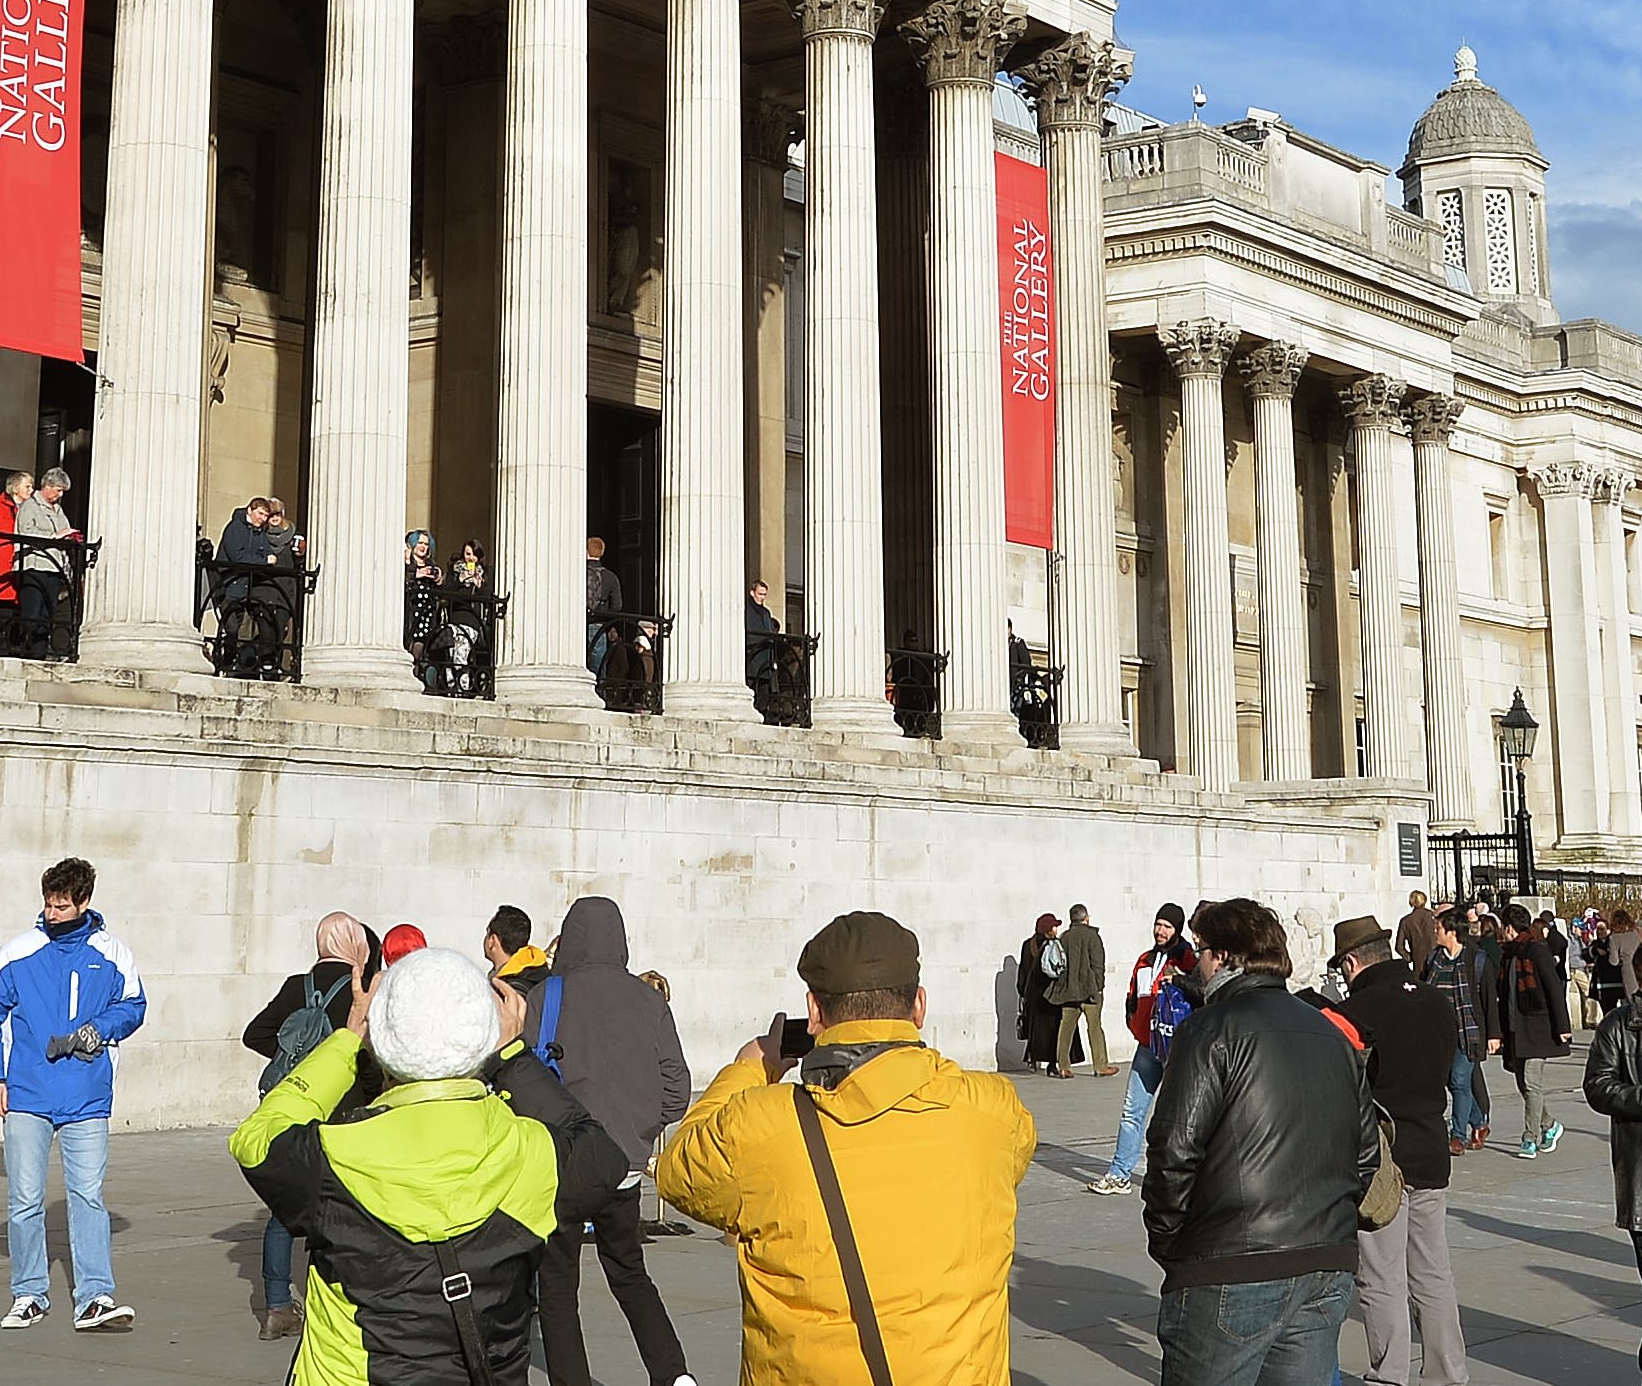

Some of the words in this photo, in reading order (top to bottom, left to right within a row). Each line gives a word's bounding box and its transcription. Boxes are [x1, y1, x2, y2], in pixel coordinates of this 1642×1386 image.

[1003, 310, 1013, 347] THE
[1012, 218, 1030, 397] NATIONAL
[1029, 220, 1050, 402] GALLERY
